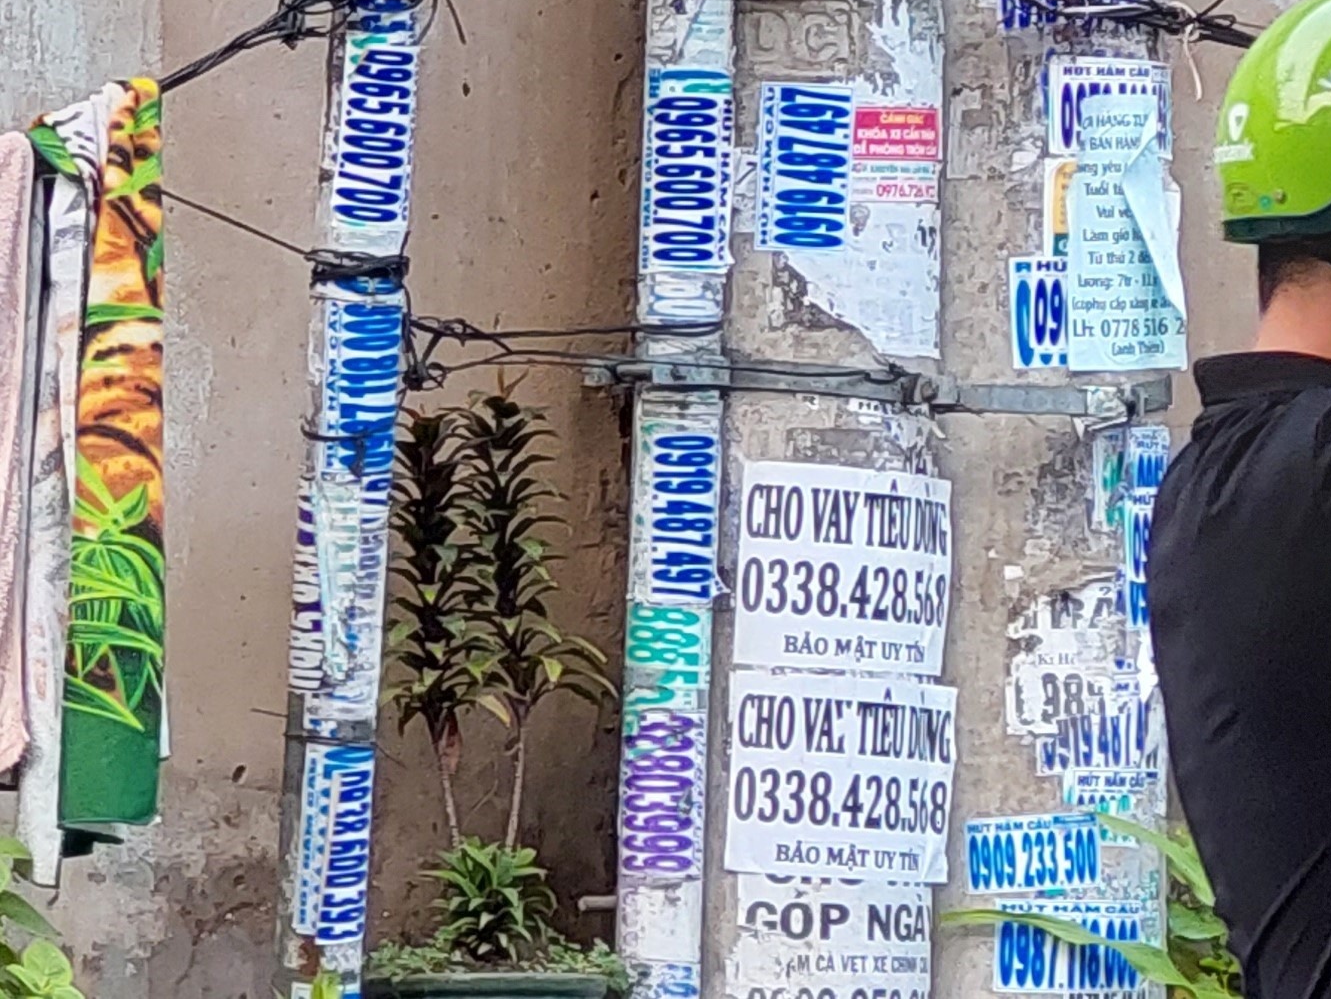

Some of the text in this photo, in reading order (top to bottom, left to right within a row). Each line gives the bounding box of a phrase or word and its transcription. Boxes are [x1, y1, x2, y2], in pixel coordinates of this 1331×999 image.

[652, 96, 719, 263] 0965.600.700
[774, 87, 851, 248] 0919.487.497
[1101, 318, 1140, 338] 0778
[1143, 317, 1169, 337] 516
[652, 435, 716, 600] 0919.487.497
[746, 483, 804, 541] CHO
[811, 487, 861, 545] VAY
[864, 478, 912, 550] TIÊU
[742, 557, 947, 628] 0338.428.568
[784, 631, 828, 656] BẢO
[834, 635, 877, 662] MẬT
[881, 643, 903, 662] UY
[738, 693, 796, 750] CHO
[857, 687, 907, 758] TIÊU
[734, 766, 948, 835] 0338.428.568
[775, 840, 820, 864] BẢO
[826, 843, 870, 871] MẬT
[873, 849, 898, 870] UY
[969, 828, 1098, 890] 0909.233.500
